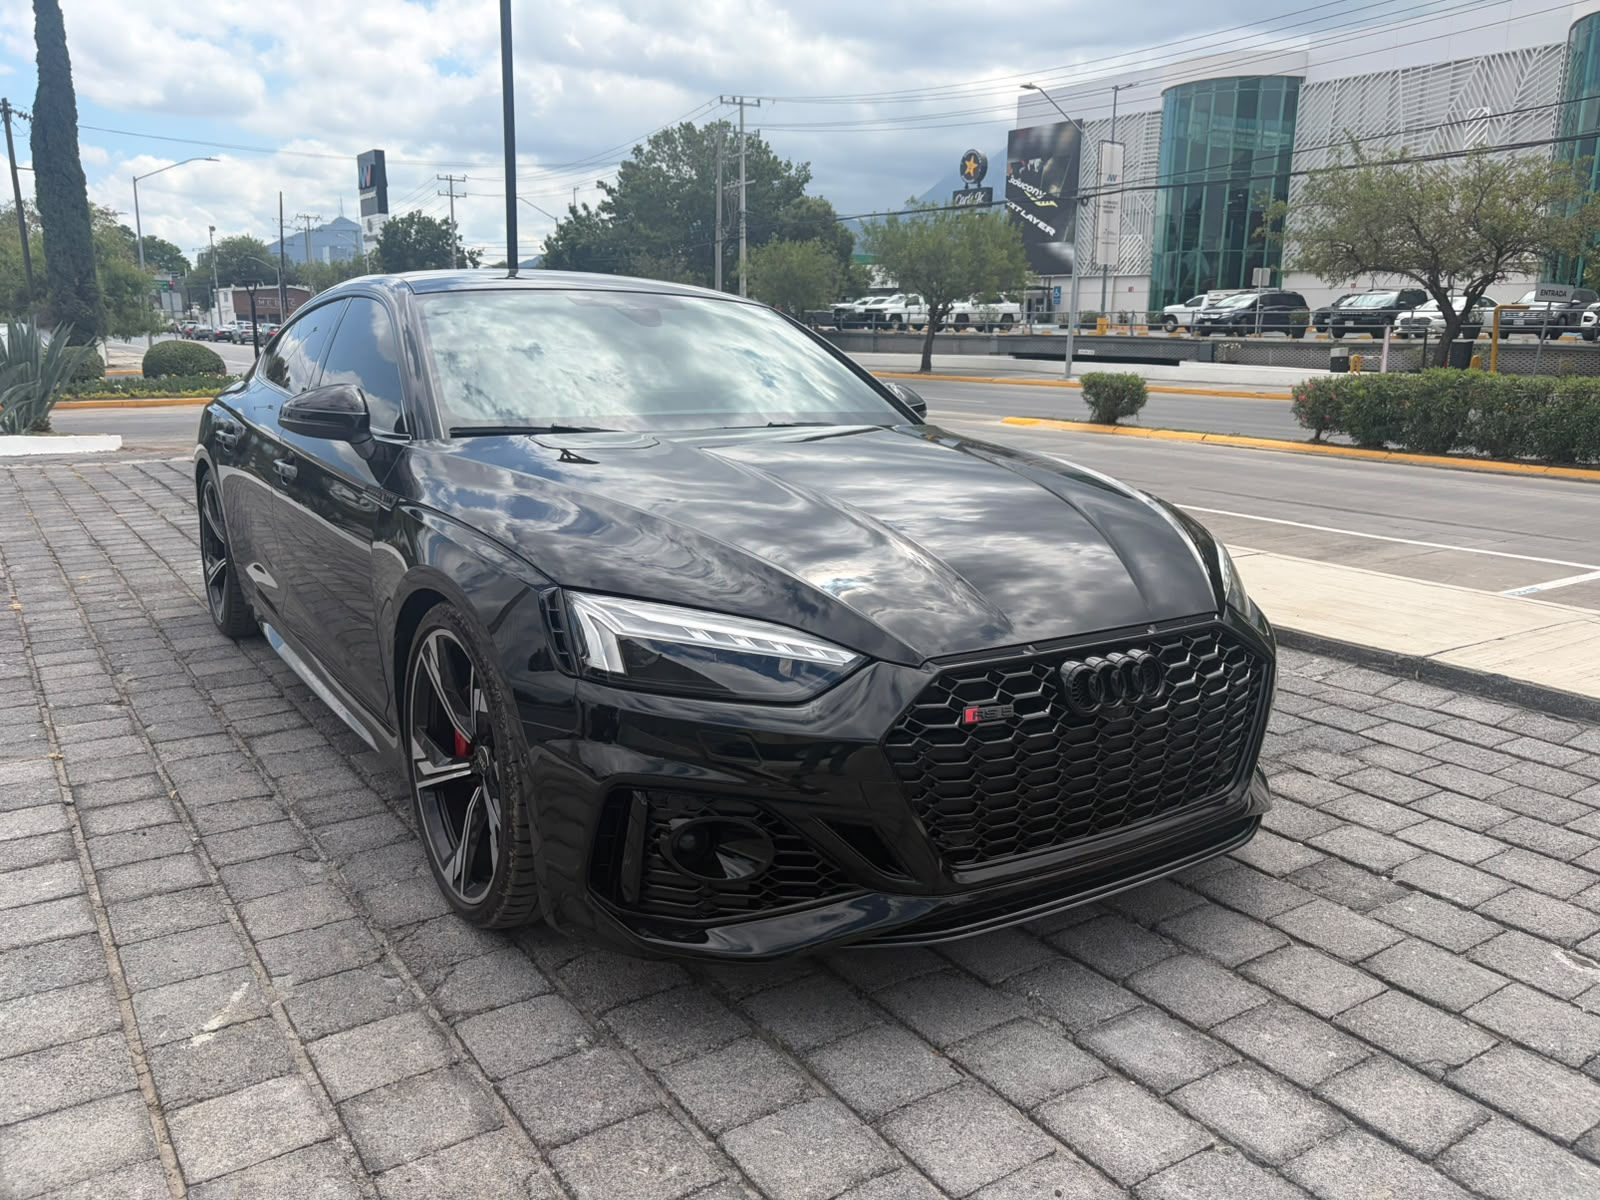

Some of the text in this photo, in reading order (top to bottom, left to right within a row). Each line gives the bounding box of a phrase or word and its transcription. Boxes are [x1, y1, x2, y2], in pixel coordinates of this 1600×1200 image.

[1008, 176, 1047, 199] saucony
[1020, 210, 1056, 236] LAYER
[1540, 289, 1567, 297] ENTRADA
[974, 707, 998, 721] RS
